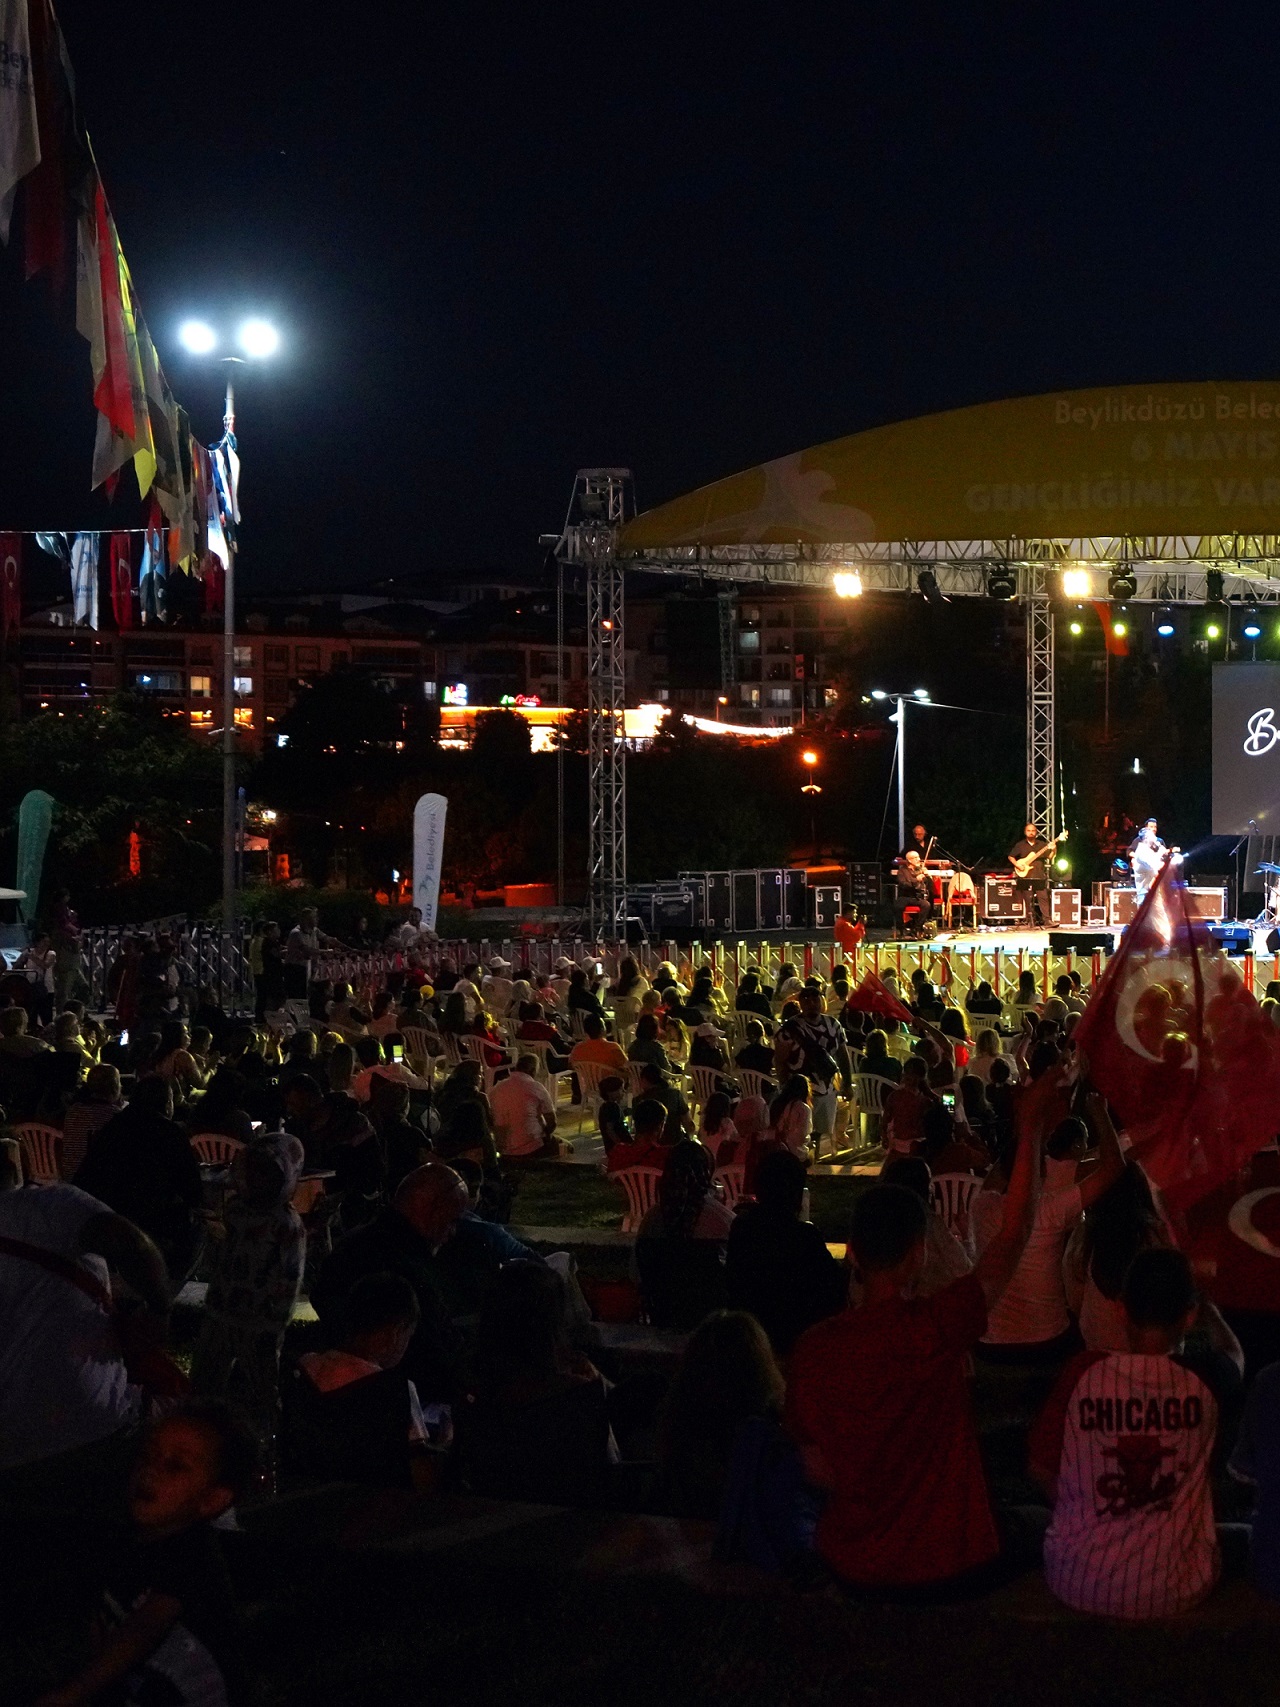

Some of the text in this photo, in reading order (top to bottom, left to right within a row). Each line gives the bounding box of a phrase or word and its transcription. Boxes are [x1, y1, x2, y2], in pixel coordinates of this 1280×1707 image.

[1055, 396, 1205, 429] Beylikdüzü
[1130, 431, 1278, 461] 6 MAYIS
[426, 812, 437, 871] Belediyesi
[1079, 1395, 1202, 1432] CHICAGO
